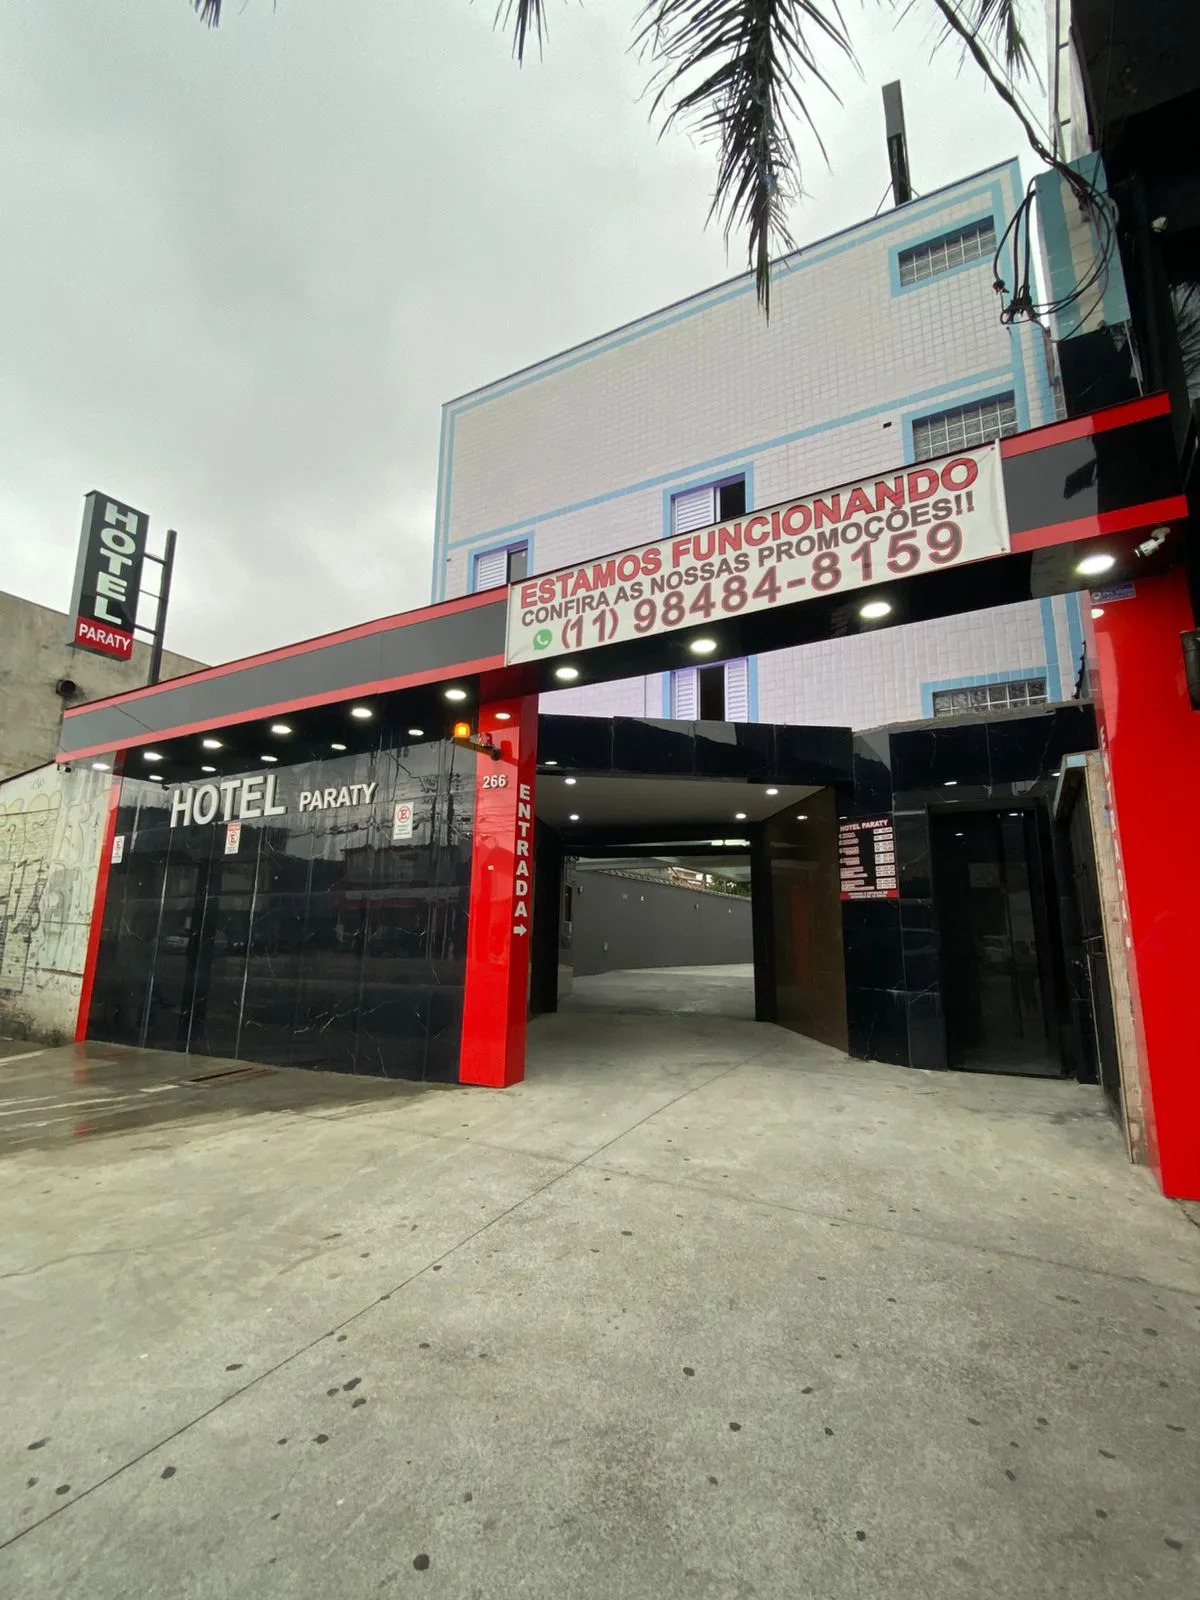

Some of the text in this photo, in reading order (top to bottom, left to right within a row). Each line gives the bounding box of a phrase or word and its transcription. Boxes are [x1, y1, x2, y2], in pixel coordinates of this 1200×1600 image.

[94, 502, 138, 626] HOTEL
[520, 457, 979, 609] ESTAMOS FUNCIONANDO
[521, 491, 975, 627] CONFIRA AS NOSSAS PROMOÇÕES!!
[561, 519, 964, 650] (11) 98484-8159
[79, 623, 131, 651] PARATY
[170, 774, 377, 828] HOTEL PARATY
[482, 774, 507, 789] 266
[840, 820, 888, 832] HOTEL PARATY
[514, 783, 531, 918] ENTRADA
